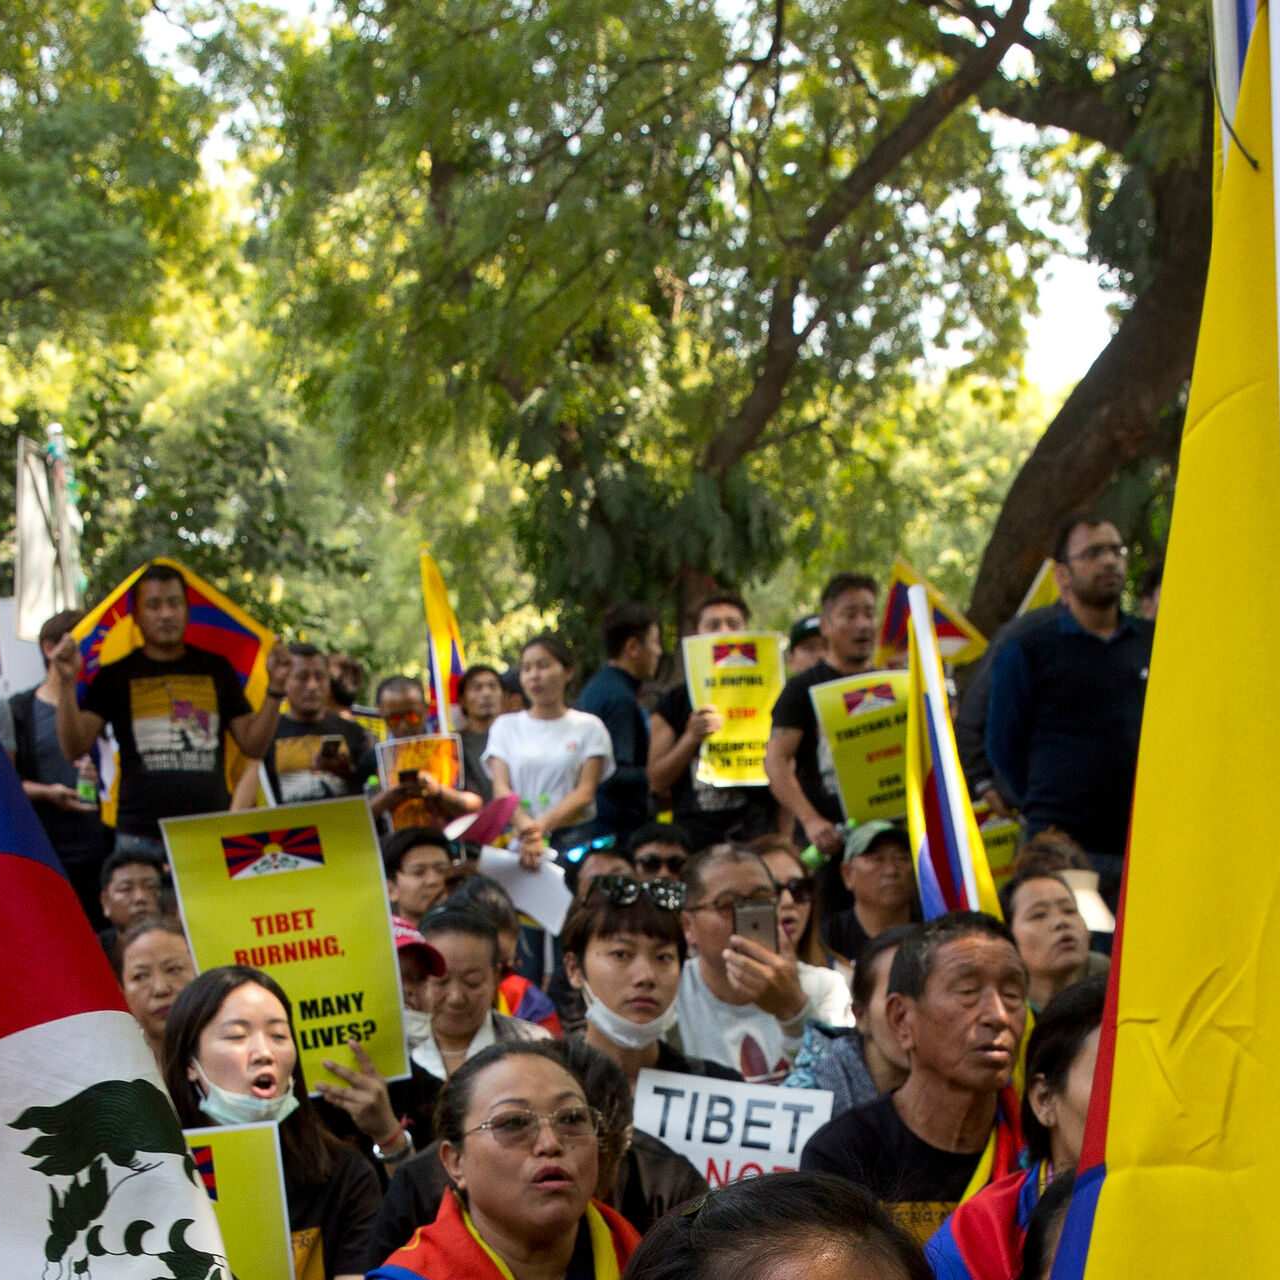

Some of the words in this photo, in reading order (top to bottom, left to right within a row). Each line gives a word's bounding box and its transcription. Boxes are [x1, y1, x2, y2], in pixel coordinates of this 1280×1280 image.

[251, 909, 315, 937] TIBET
[235, 935, 345, 967] BURNING,
[300, 992, 364, 1021] MANY
[300, 1020, 377, 1051] LIVES?
[653, 1086, 814, 1153] TIBET
